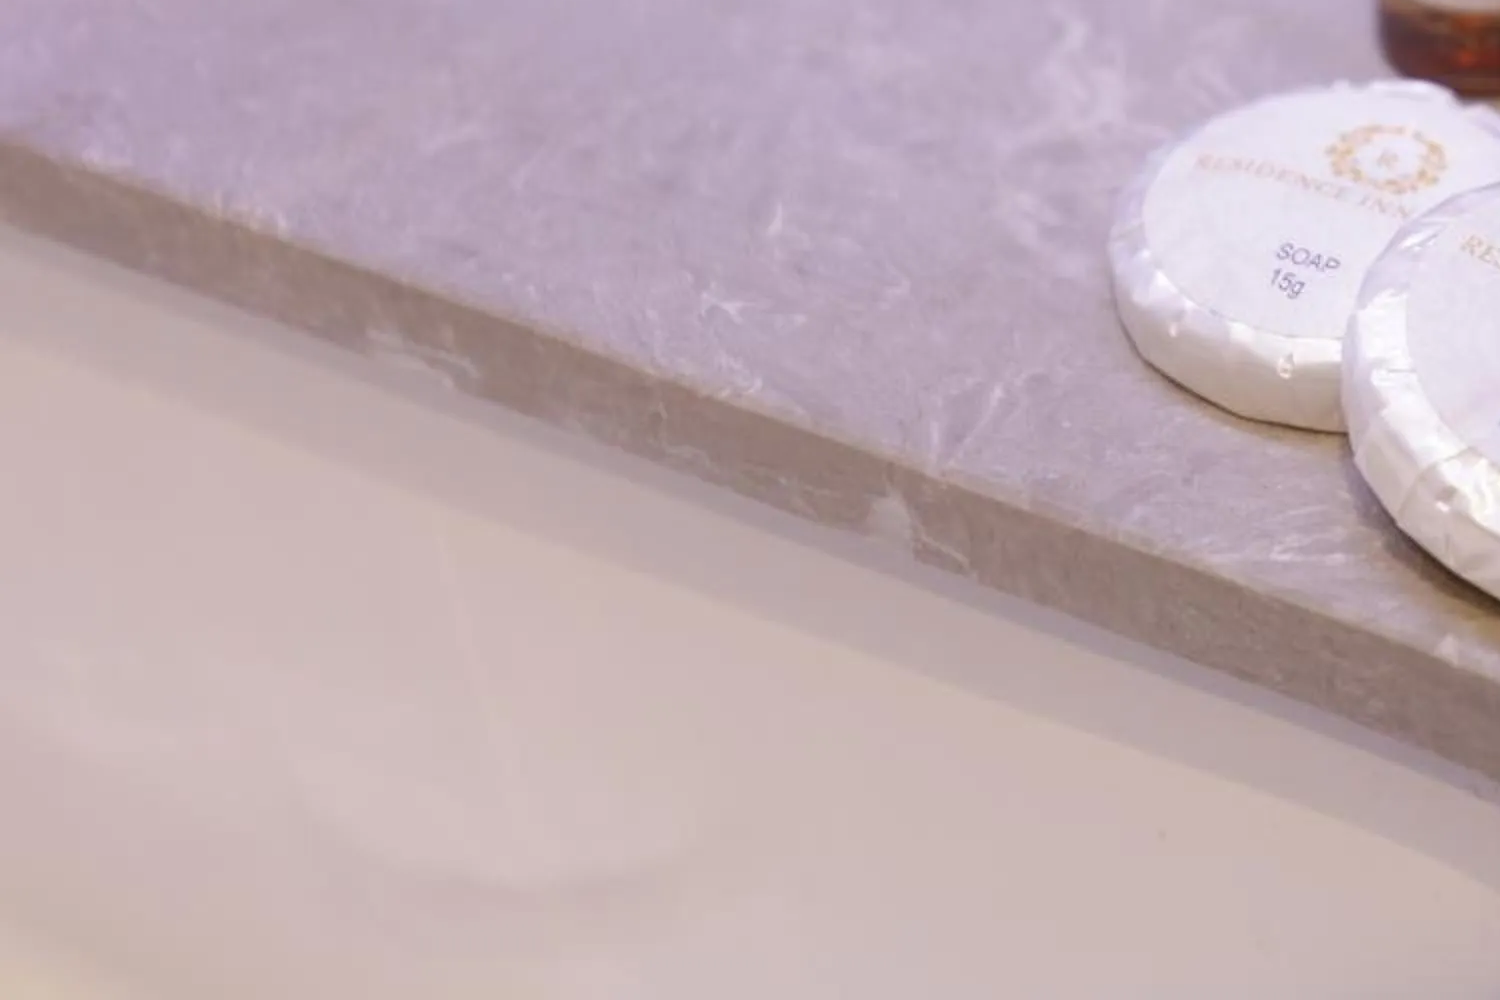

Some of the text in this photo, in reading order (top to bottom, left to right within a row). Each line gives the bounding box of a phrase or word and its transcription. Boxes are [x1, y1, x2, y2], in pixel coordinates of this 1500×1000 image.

[1357, 192, 1411, 219] INN
[1275, 241, 1342, 273] SOAP
[1270, 266, 1306, 301] 15g
